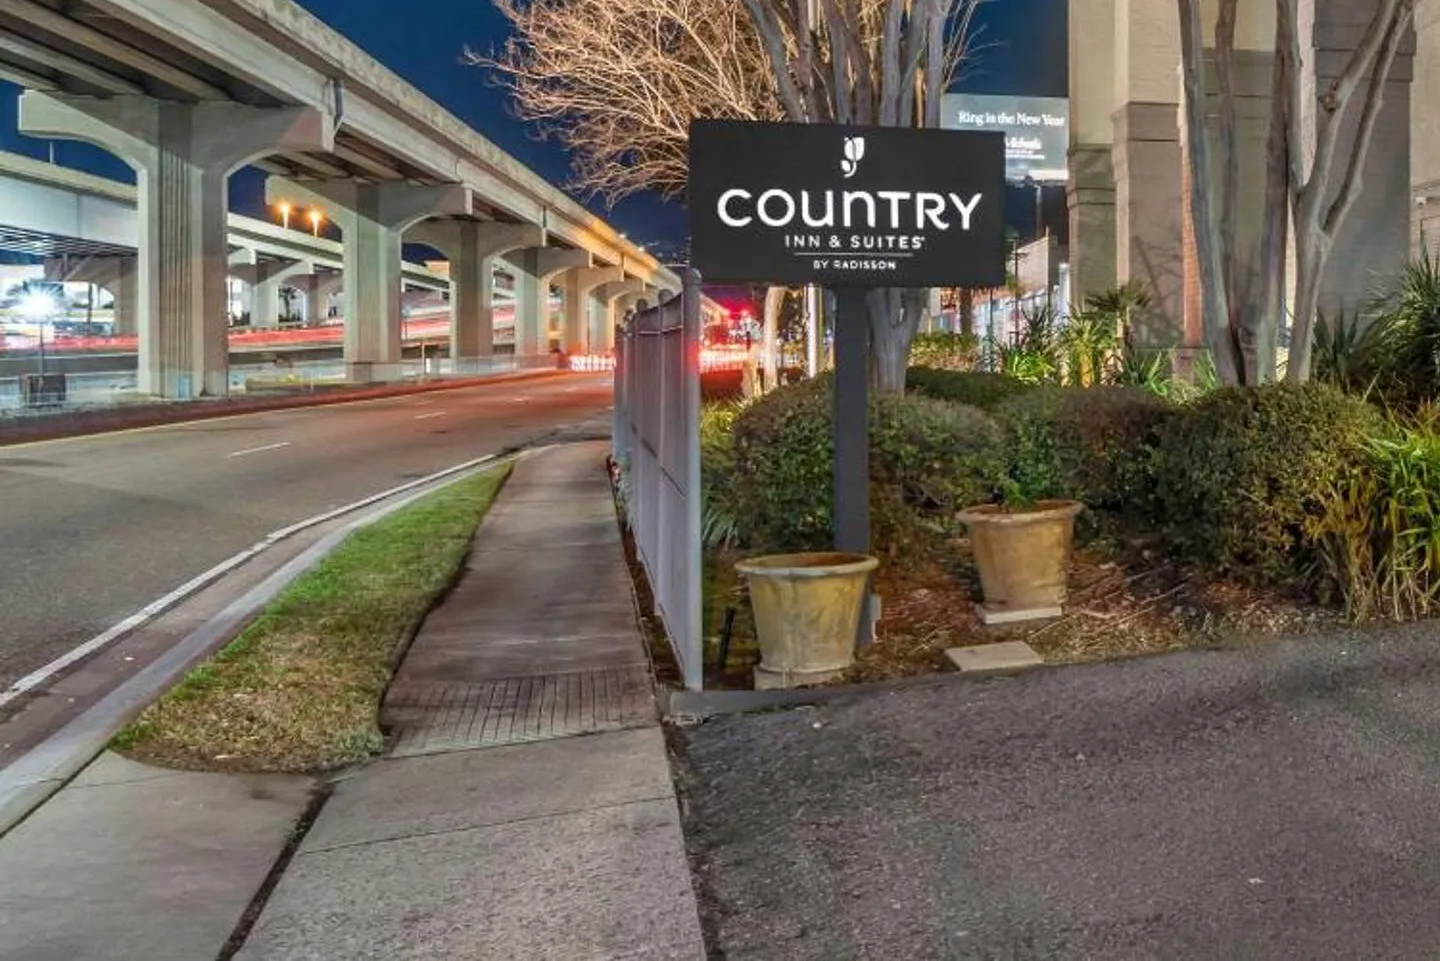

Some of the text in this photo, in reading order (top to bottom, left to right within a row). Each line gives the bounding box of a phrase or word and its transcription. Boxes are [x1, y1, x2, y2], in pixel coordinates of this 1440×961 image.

[958, 110, 984, 126] Ring
[985, 111, 996, 124] in
[998, 111, 1015, 125] the
[1016, 111, 1040, 126] New
[785, 235, 923, 250] INN & SUITES
[813, 259, 897, 271] BY RADISSON
